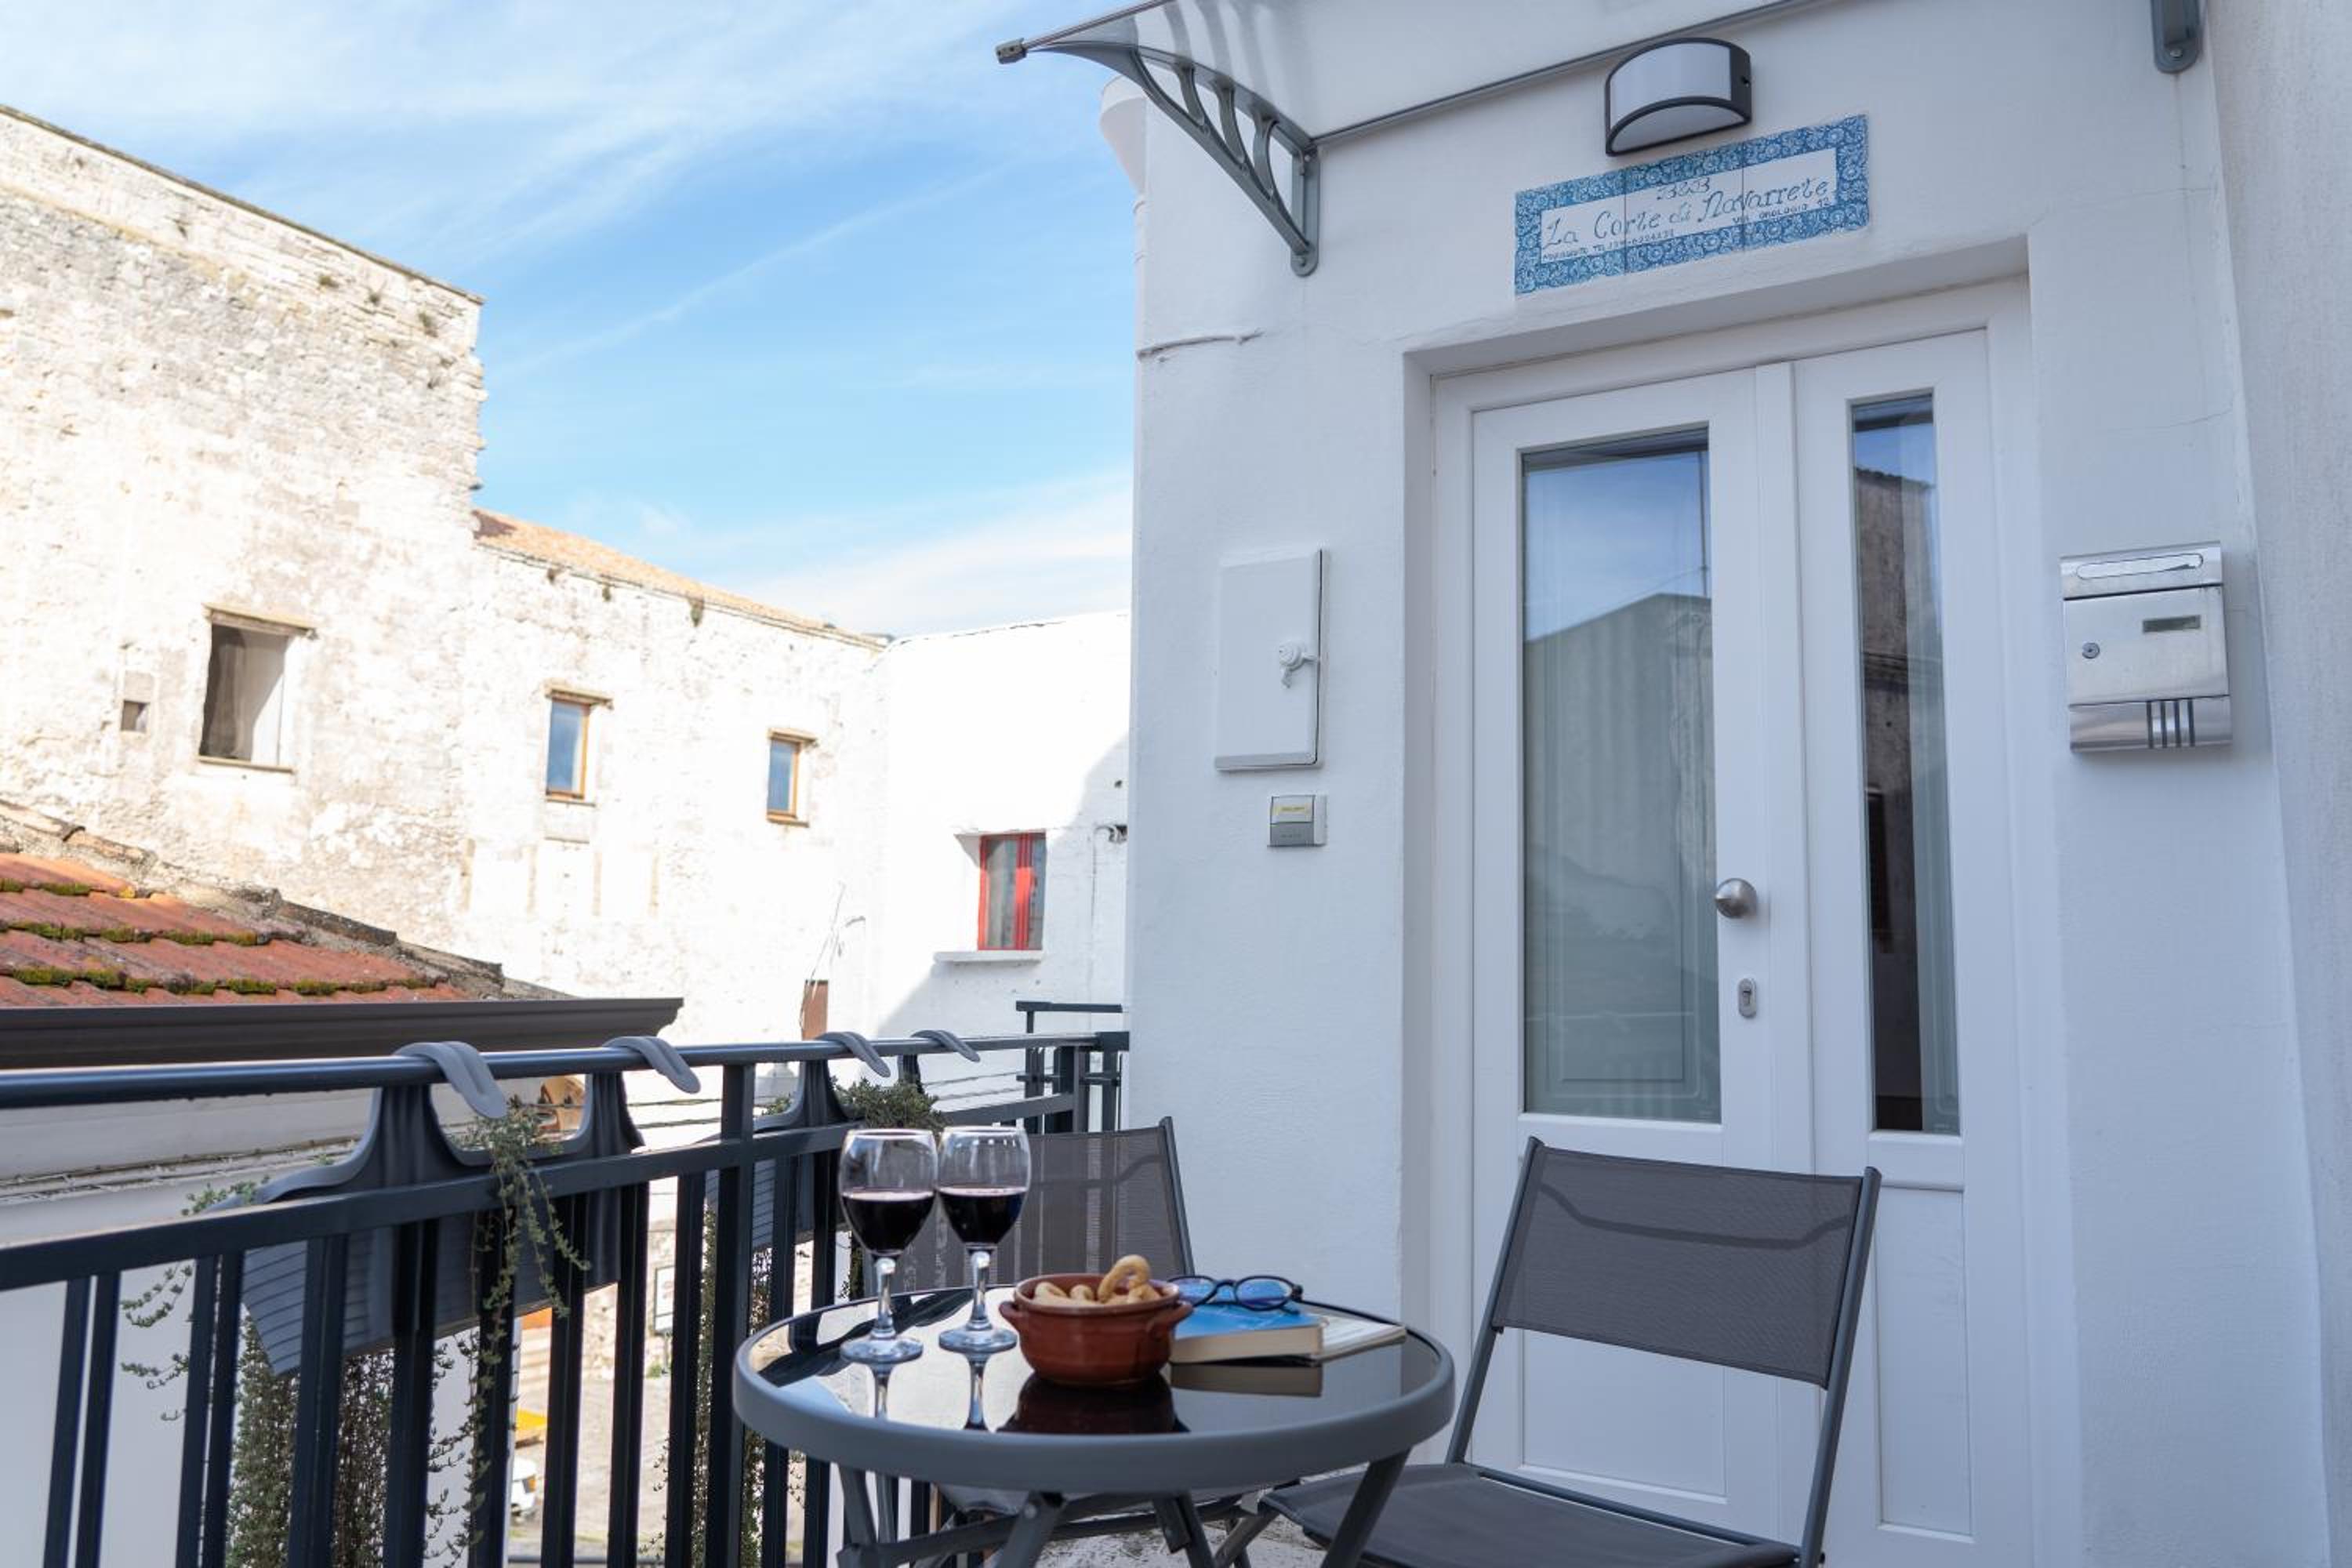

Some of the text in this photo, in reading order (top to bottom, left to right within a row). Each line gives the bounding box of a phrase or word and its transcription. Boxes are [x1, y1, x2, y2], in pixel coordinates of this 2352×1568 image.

[1543, 217, 1579, 249] La
[1594, 210, 1661, 240] Corte
[1697, 177, 1829, 223] Navarrete
